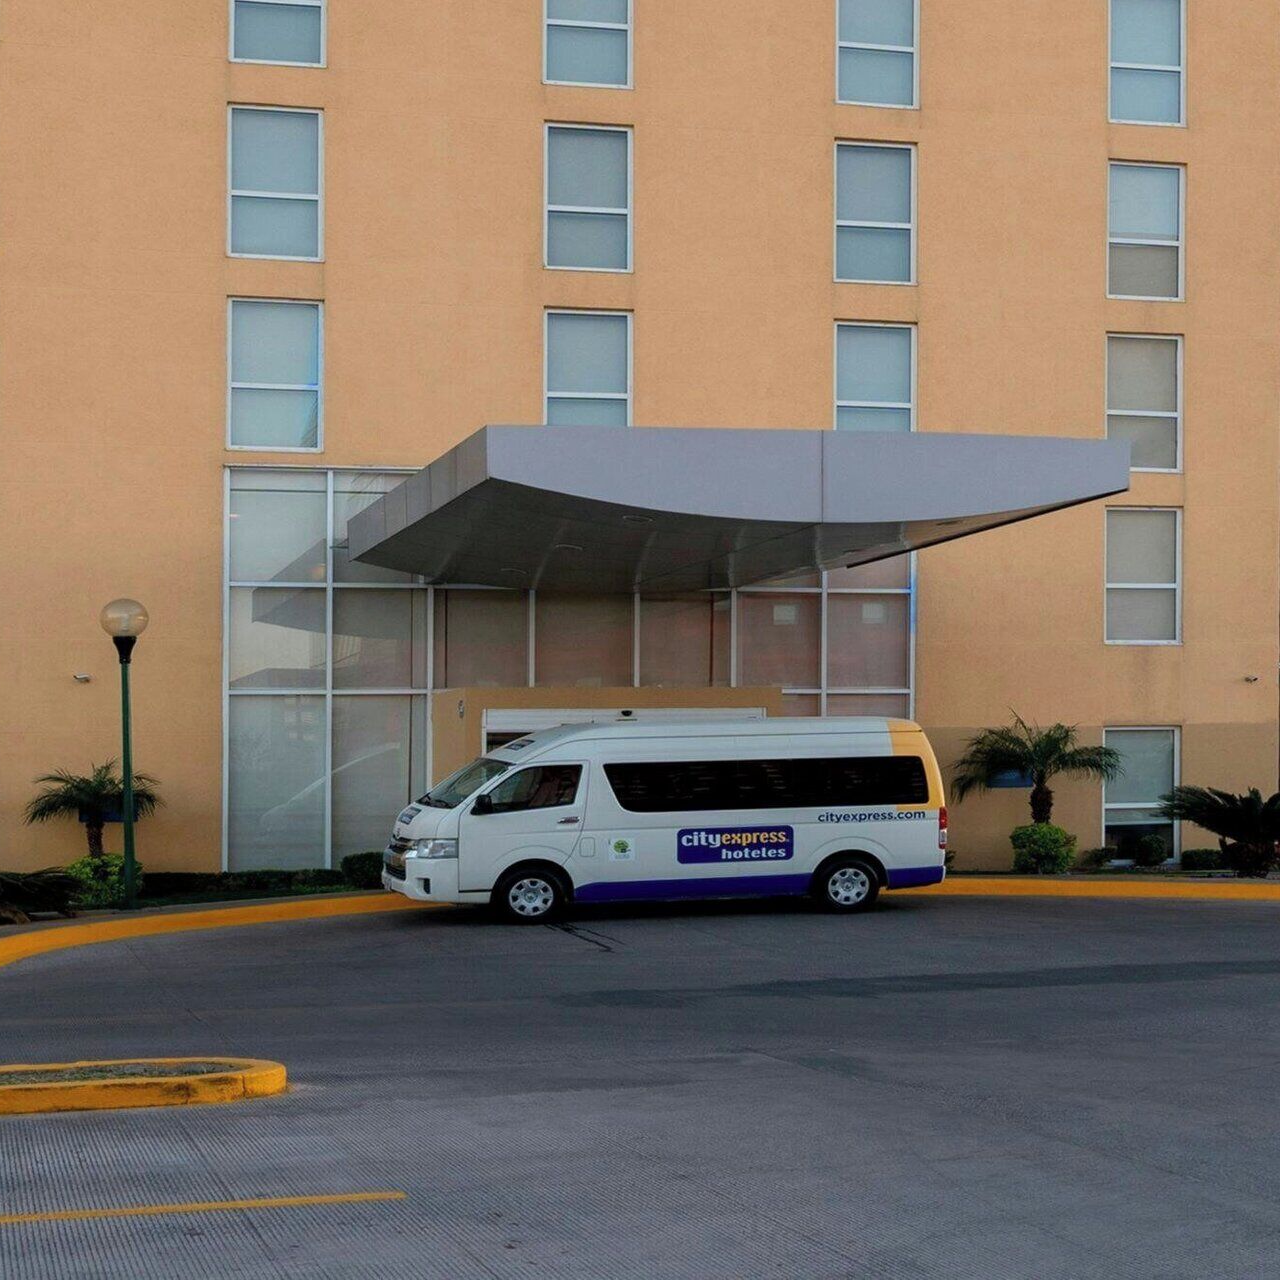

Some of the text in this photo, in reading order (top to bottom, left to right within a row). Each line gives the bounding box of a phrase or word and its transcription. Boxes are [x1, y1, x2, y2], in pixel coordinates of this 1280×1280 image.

[817, 810, 926, 824] cityexpress.com
[681, 831, 787, 848] cityexpress
[721, 847, 786, 860] hoteles
